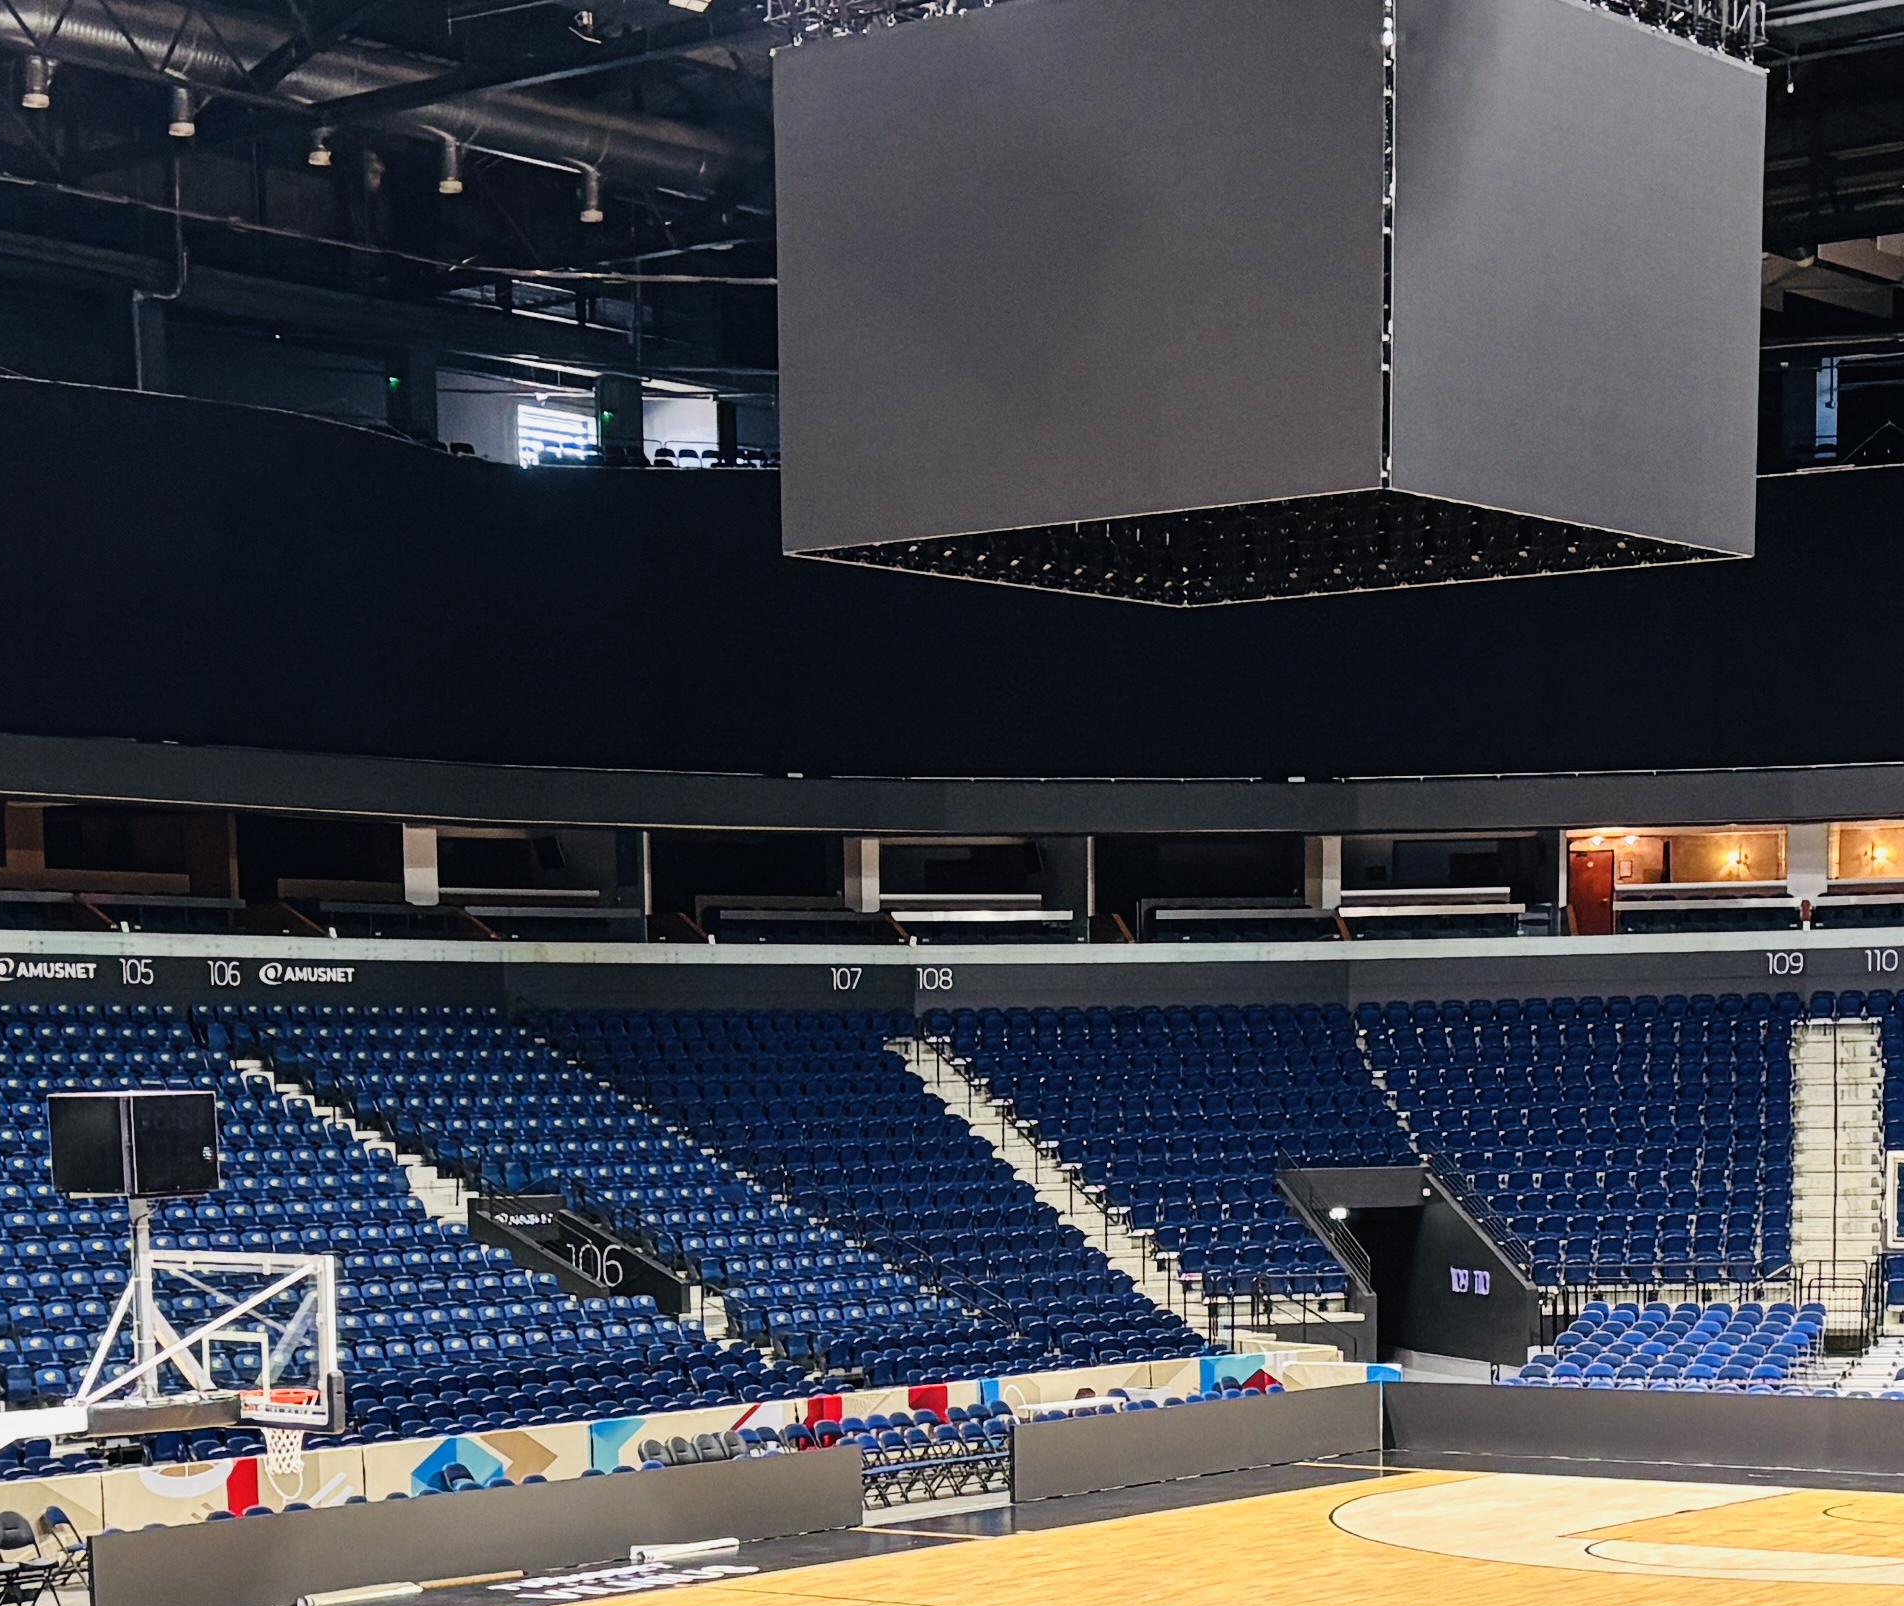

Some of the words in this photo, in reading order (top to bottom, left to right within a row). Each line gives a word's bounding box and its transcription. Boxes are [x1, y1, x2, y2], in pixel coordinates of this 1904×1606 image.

[16, 962, 97, 979] AMUSNET
[1767, 952, 1803, 974] 109
[1865, 950, 1898, 971] 110
[120, 959, 153, 985] 105
[208, 961, 241, 986] 106
[283, 967, 354, 982] AMUSNET
[831, 968, 862, 990] 107
[917, 968, 953, 990] 108
[566, 1244, 623, 1287] 106
